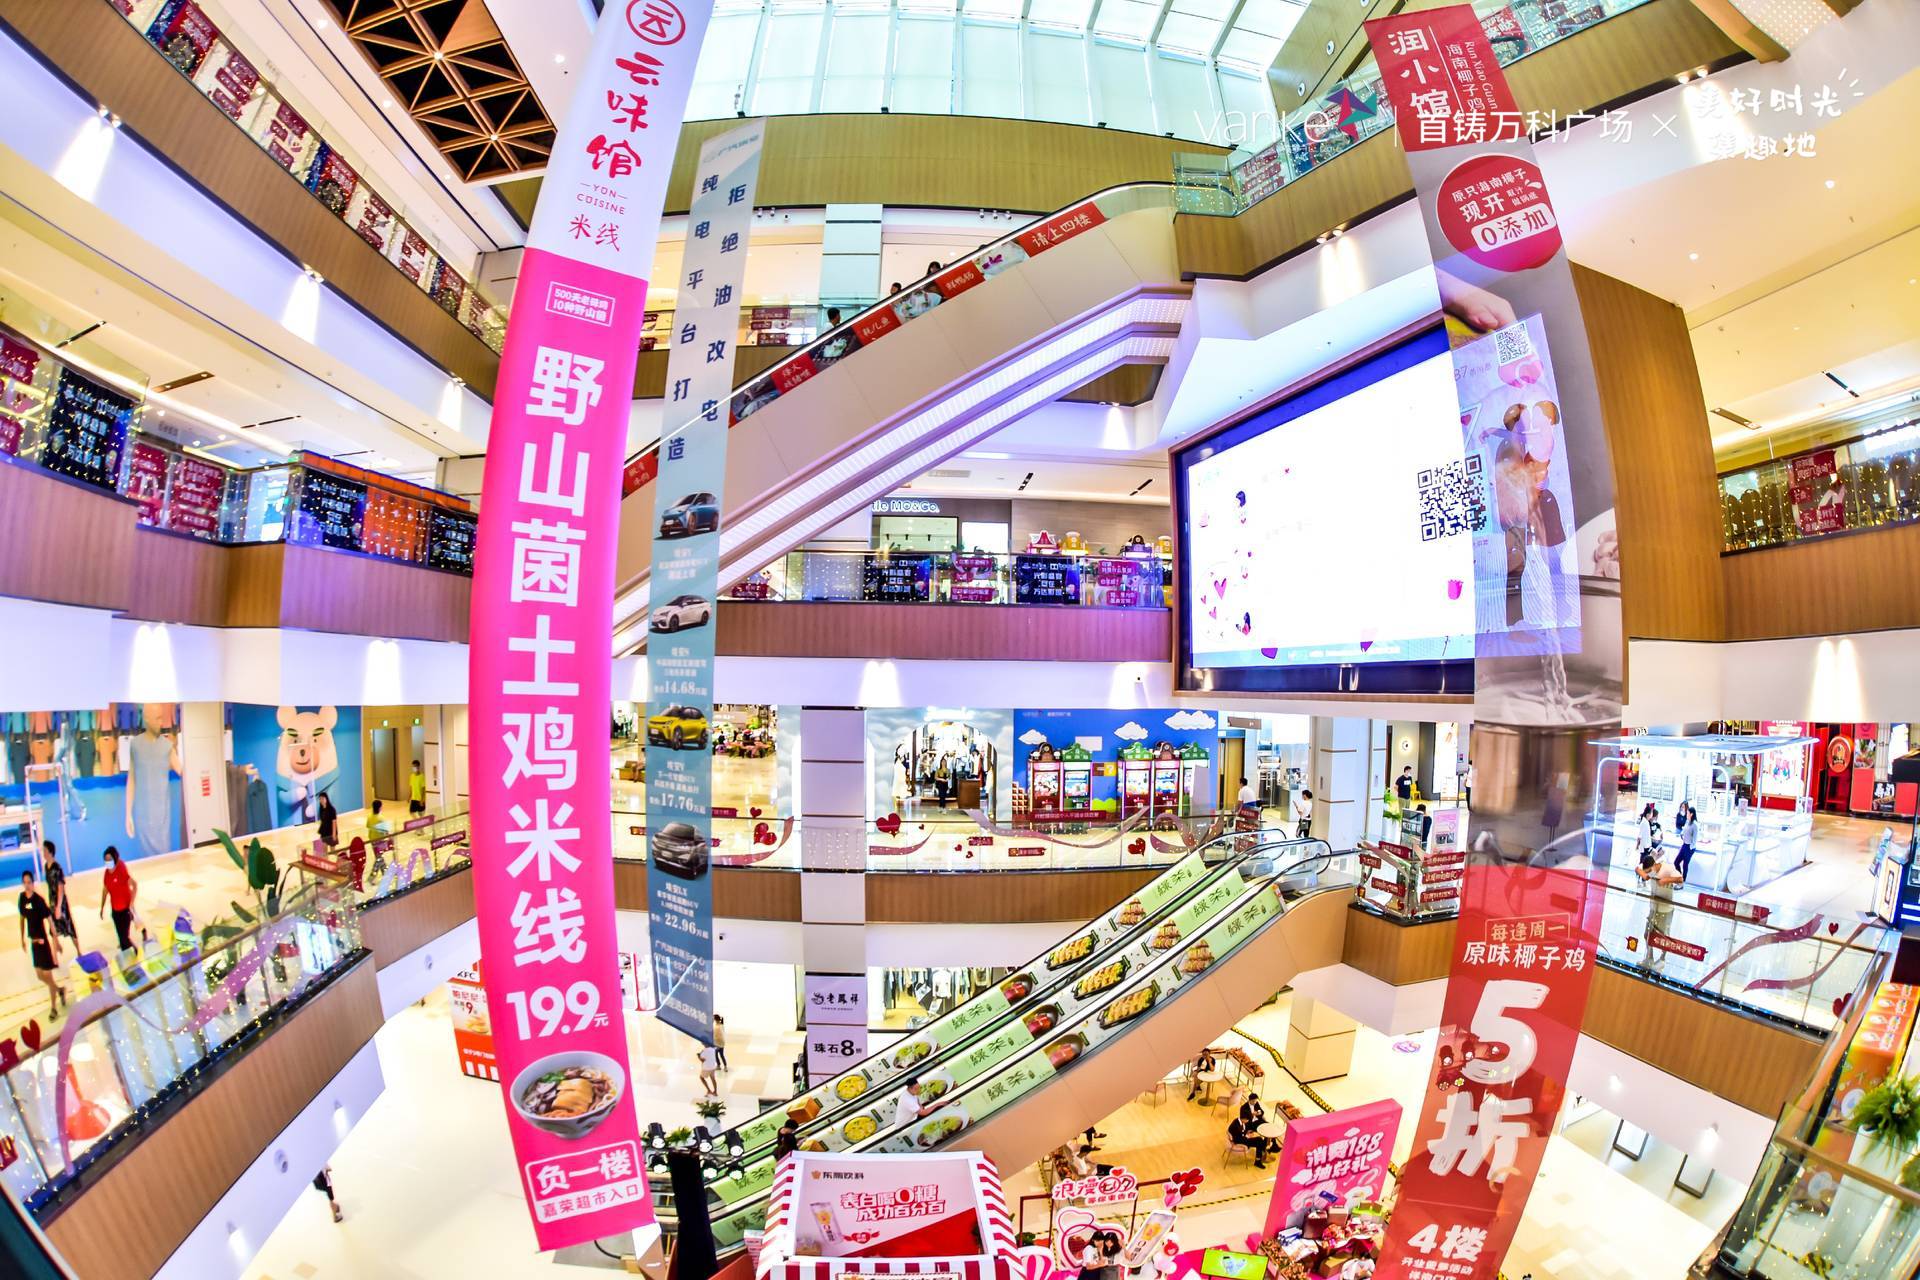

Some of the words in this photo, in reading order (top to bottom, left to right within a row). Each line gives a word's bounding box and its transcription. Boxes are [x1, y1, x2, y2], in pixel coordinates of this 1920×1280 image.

[1388, 29, 1451, 117] 润小馆
[1445, 44, 1485, 111] 海南椰子鸡
[1465, 41, 1477, 59] Run
[1474, 60, 1486, 81] Xiao
[1482, 82, 1498, 109] Guan
[586, 52, 665, 178] 云味馆
[1452, 168, 1526, 203] 原只海南椰子
[1460, 192, 1505, 223] 现开
[569, 214, 620, 251] 米线
[1032, 211, 1092, 248] 请上四楼
[1481, 210, 1549, 246] 0添加
[668, 174, 718, 461] 纯电平台打造
[701, 184, 746, 421] 拒绝油改电
[502, 346, 605, 967] 野山菌土鸡米线
[1490, 920, 1566, 942] 每逢周一
[457, 970, 476, 980] KFC
[1462, 942, 1586, 972] 原味椰子鸡
[506, 980, 609, 1041] 19.9元
[1427, 979, 1550, 1182] 5折
[536, 1148, 632, 1194] 负一楼
[1055, 1175, 1135, 1198] 浪漫七夕
[541, 1183, 640, 1218] 嘉荣超市入口
[857, 1200, 946, 1222] 成功百分百
[1407, 1223, 1488, 1262] 4楼
